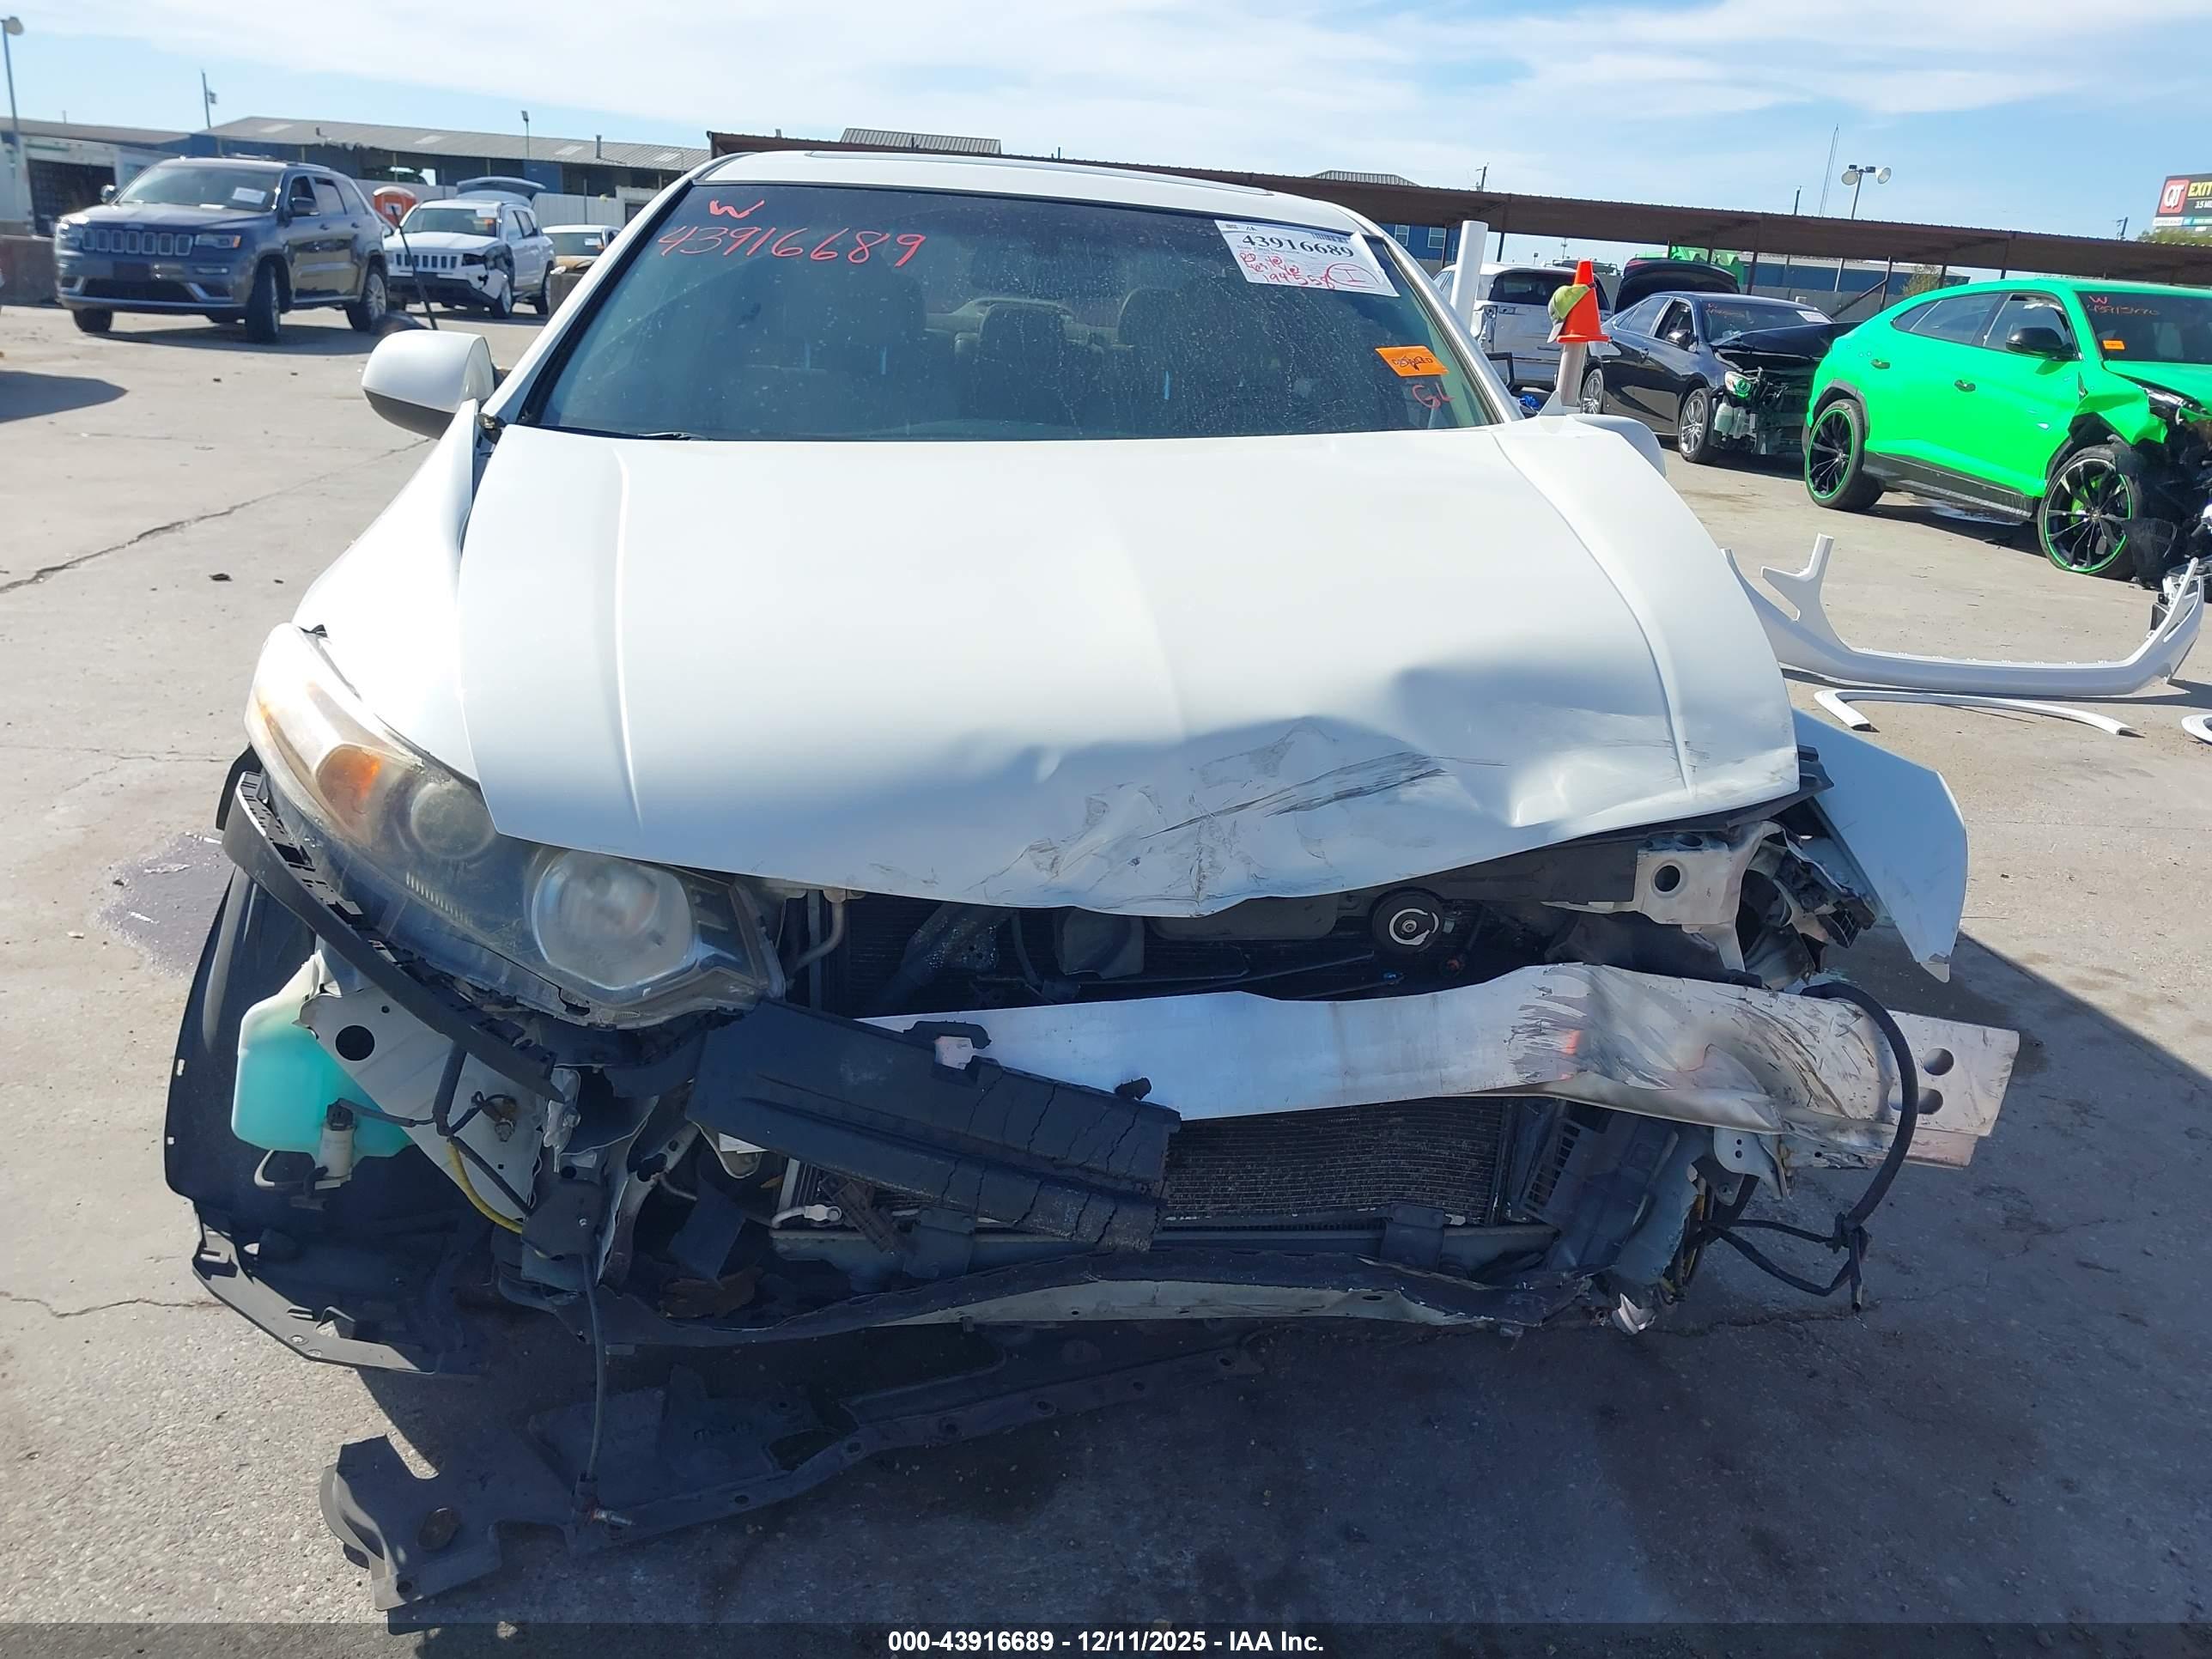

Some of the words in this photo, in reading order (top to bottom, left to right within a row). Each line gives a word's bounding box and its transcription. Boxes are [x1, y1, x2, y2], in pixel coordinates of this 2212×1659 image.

[2163, 184, 2185, 208] QT
[2187, 181, 2212, 198] EXIT
[708, 199, 765, 219] W
[658, 225, 927, 268] 43916689
[1242, 234, 1354, 258] 43916689
